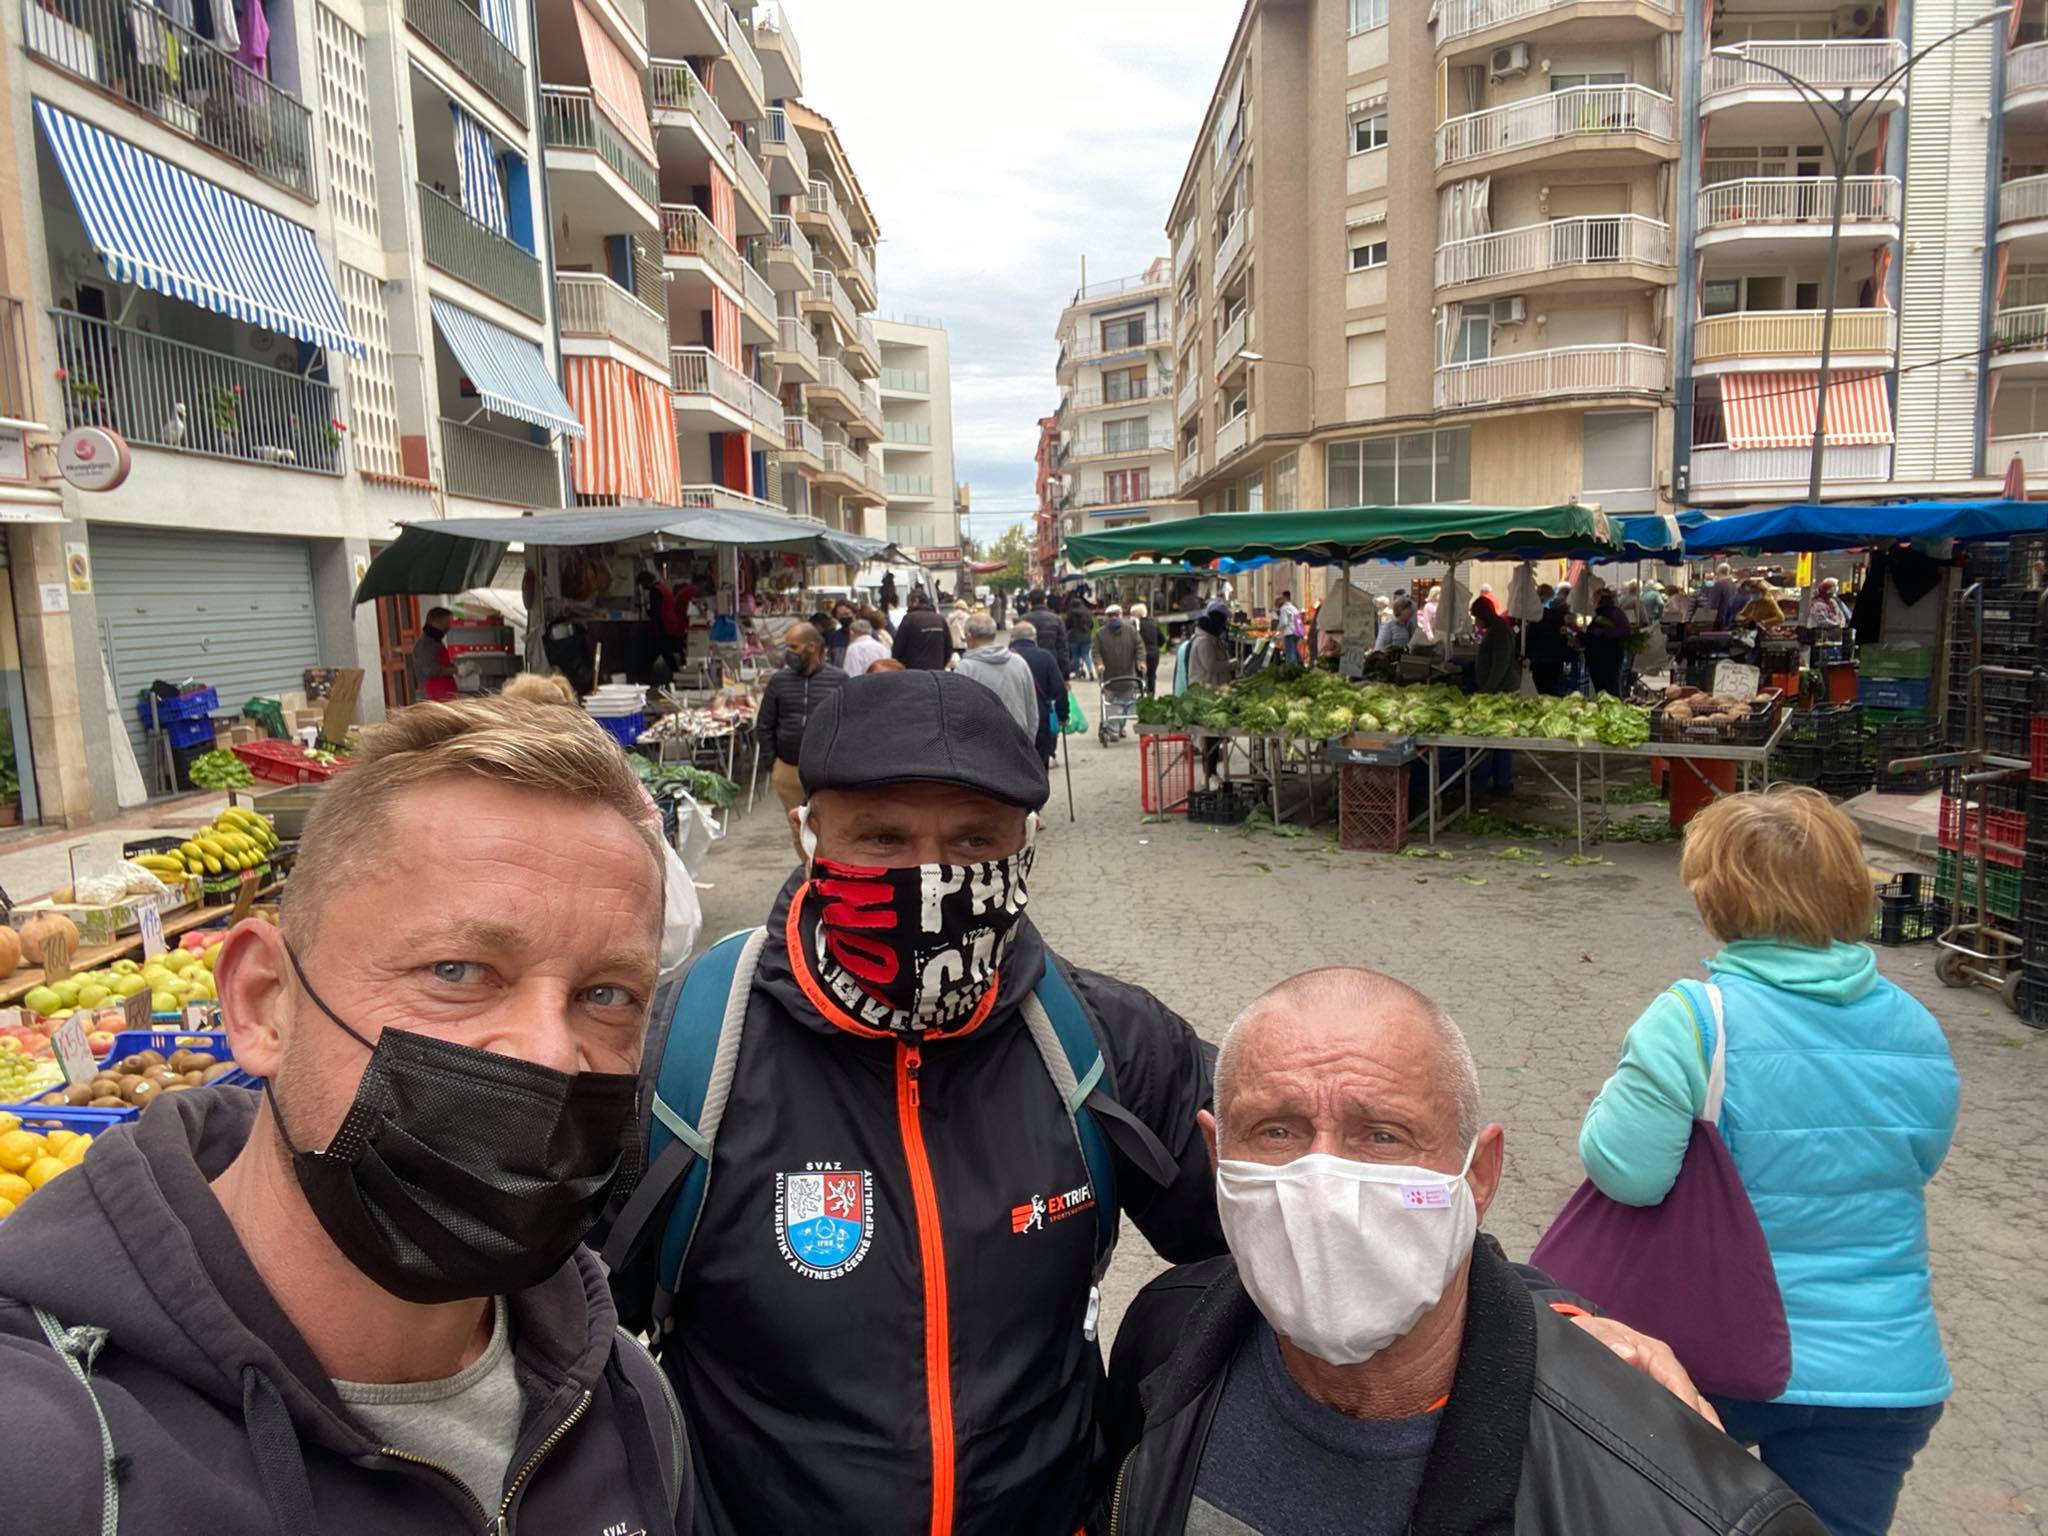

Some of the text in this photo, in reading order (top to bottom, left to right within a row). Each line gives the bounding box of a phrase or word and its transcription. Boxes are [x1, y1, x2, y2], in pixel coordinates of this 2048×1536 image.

[805, 1162, 842, 1171] SVAZ
[774, 1172, 794, 1261] KULTURISTIKY
[789, 1260, 799, 1270] A
[797, 1265, 845, 1280] FITNESS
[864, 1169, 874, 1239] REPUBLIKY
[602, 1521, 628, 1536] SVAZ
